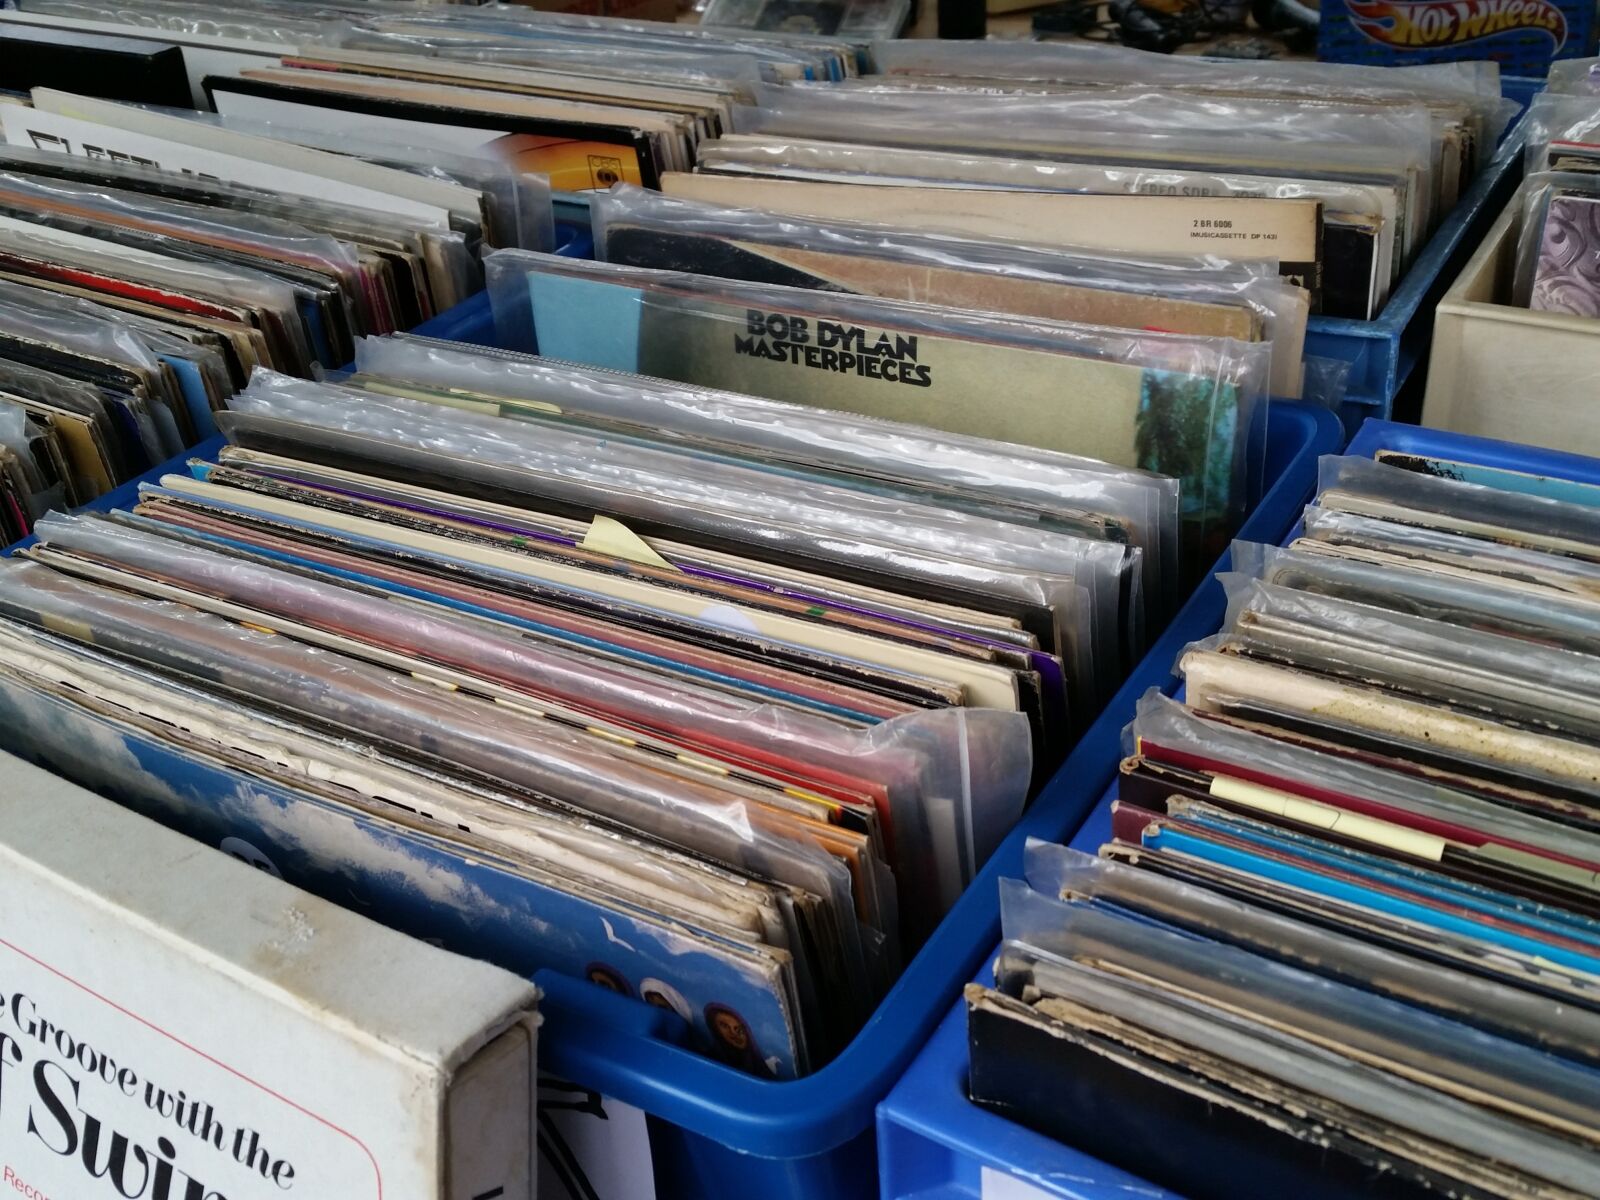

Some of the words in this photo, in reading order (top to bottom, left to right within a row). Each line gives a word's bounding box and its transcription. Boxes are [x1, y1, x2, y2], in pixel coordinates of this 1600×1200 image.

[1193, 219, 1198, 228] 2
[734, 333, 932, 388] MASTERPIECES
[746, 309, 810, 344] BOB
[817, 320, 918, 362] DYLAN
[11, 992, 138, 1097] Groove
[144, 1079, 228, 1151] with
[232, 1127, 295, 1190] the
[4, 1165, 50, 1200] Reco
